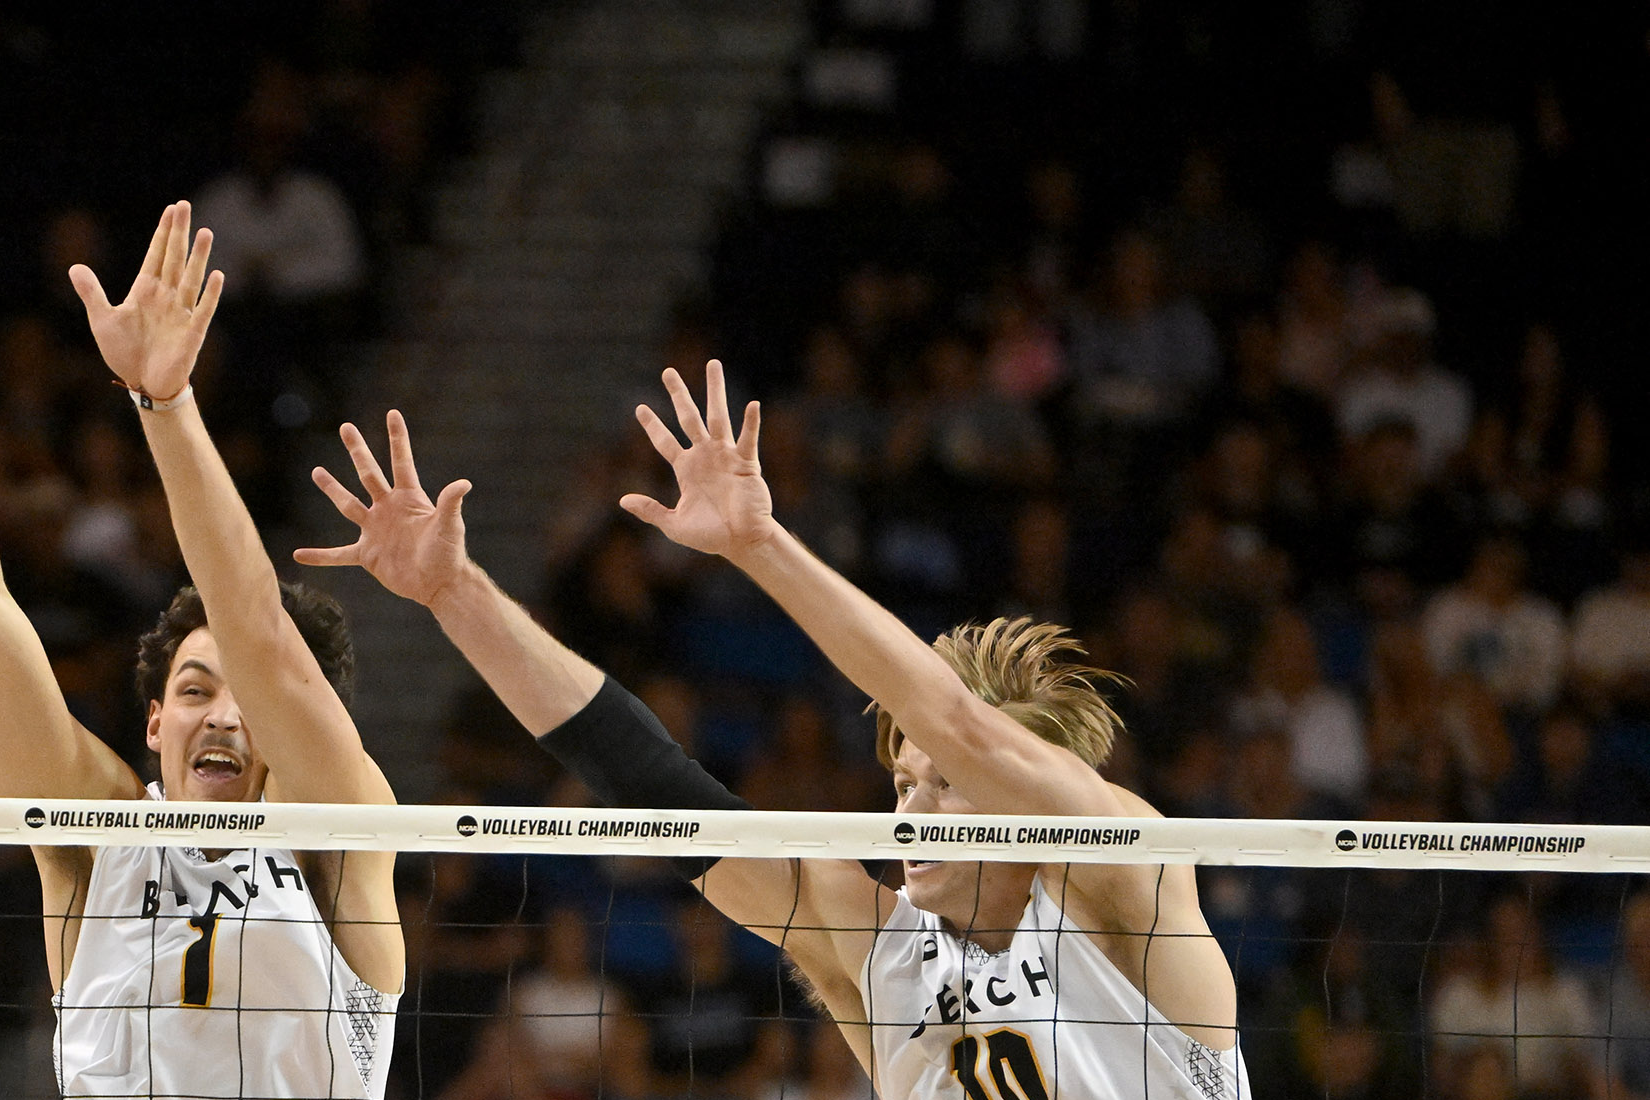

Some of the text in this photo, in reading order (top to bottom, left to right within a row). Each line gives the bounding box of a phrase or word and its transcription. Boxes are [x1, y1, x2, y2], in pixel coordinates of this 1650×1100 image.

[50, 810, 140, 829] VOLLEYBALL
[144, 812, 266, 831] CHAMPIONSHIP
[482, 818, 573, 837] VOLLEYBALL
[578, 820, 700, 839] CHAMPIONSHIP
[920, 825, 1012, 844] VOLLEYBALL
[1016, 827, 1141, 846] CHAMPIONSHIP
[1362, 832, 1455, 851] VOLLEYBALL
[1459, 834, 1586, 853] CHAMPIONSHIP
[179, 912, 225, 1008] 1
